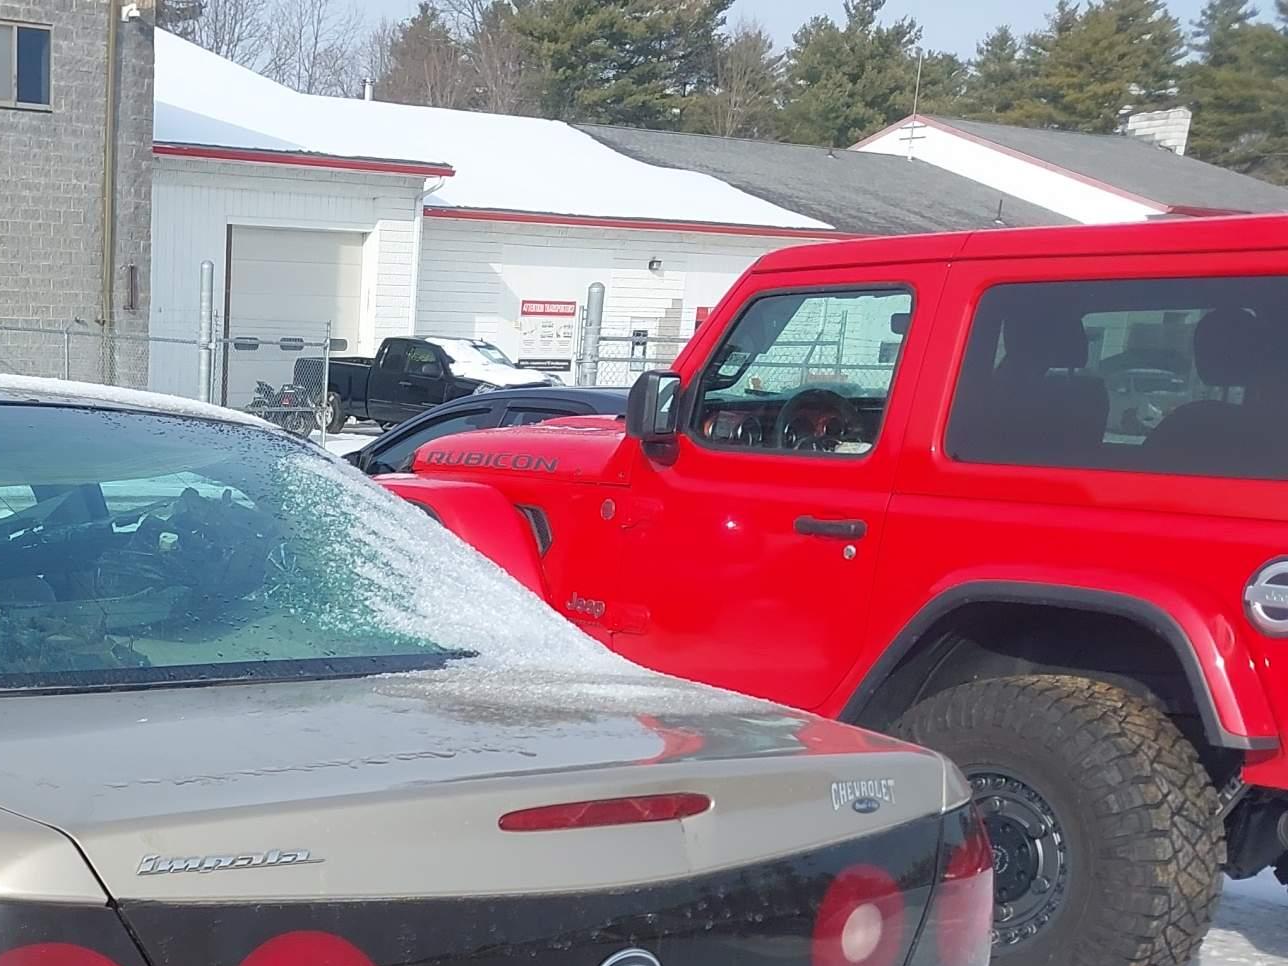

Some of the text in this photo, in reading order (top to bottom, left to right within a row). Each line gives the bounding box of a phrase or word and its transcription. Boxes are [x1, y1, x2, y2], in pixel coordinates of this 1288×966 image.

[425, 451, 559, 473] RUBICON
[566, 591, 606, 619] Jeep
[831, 779, 896, 811] CHEVROLET
